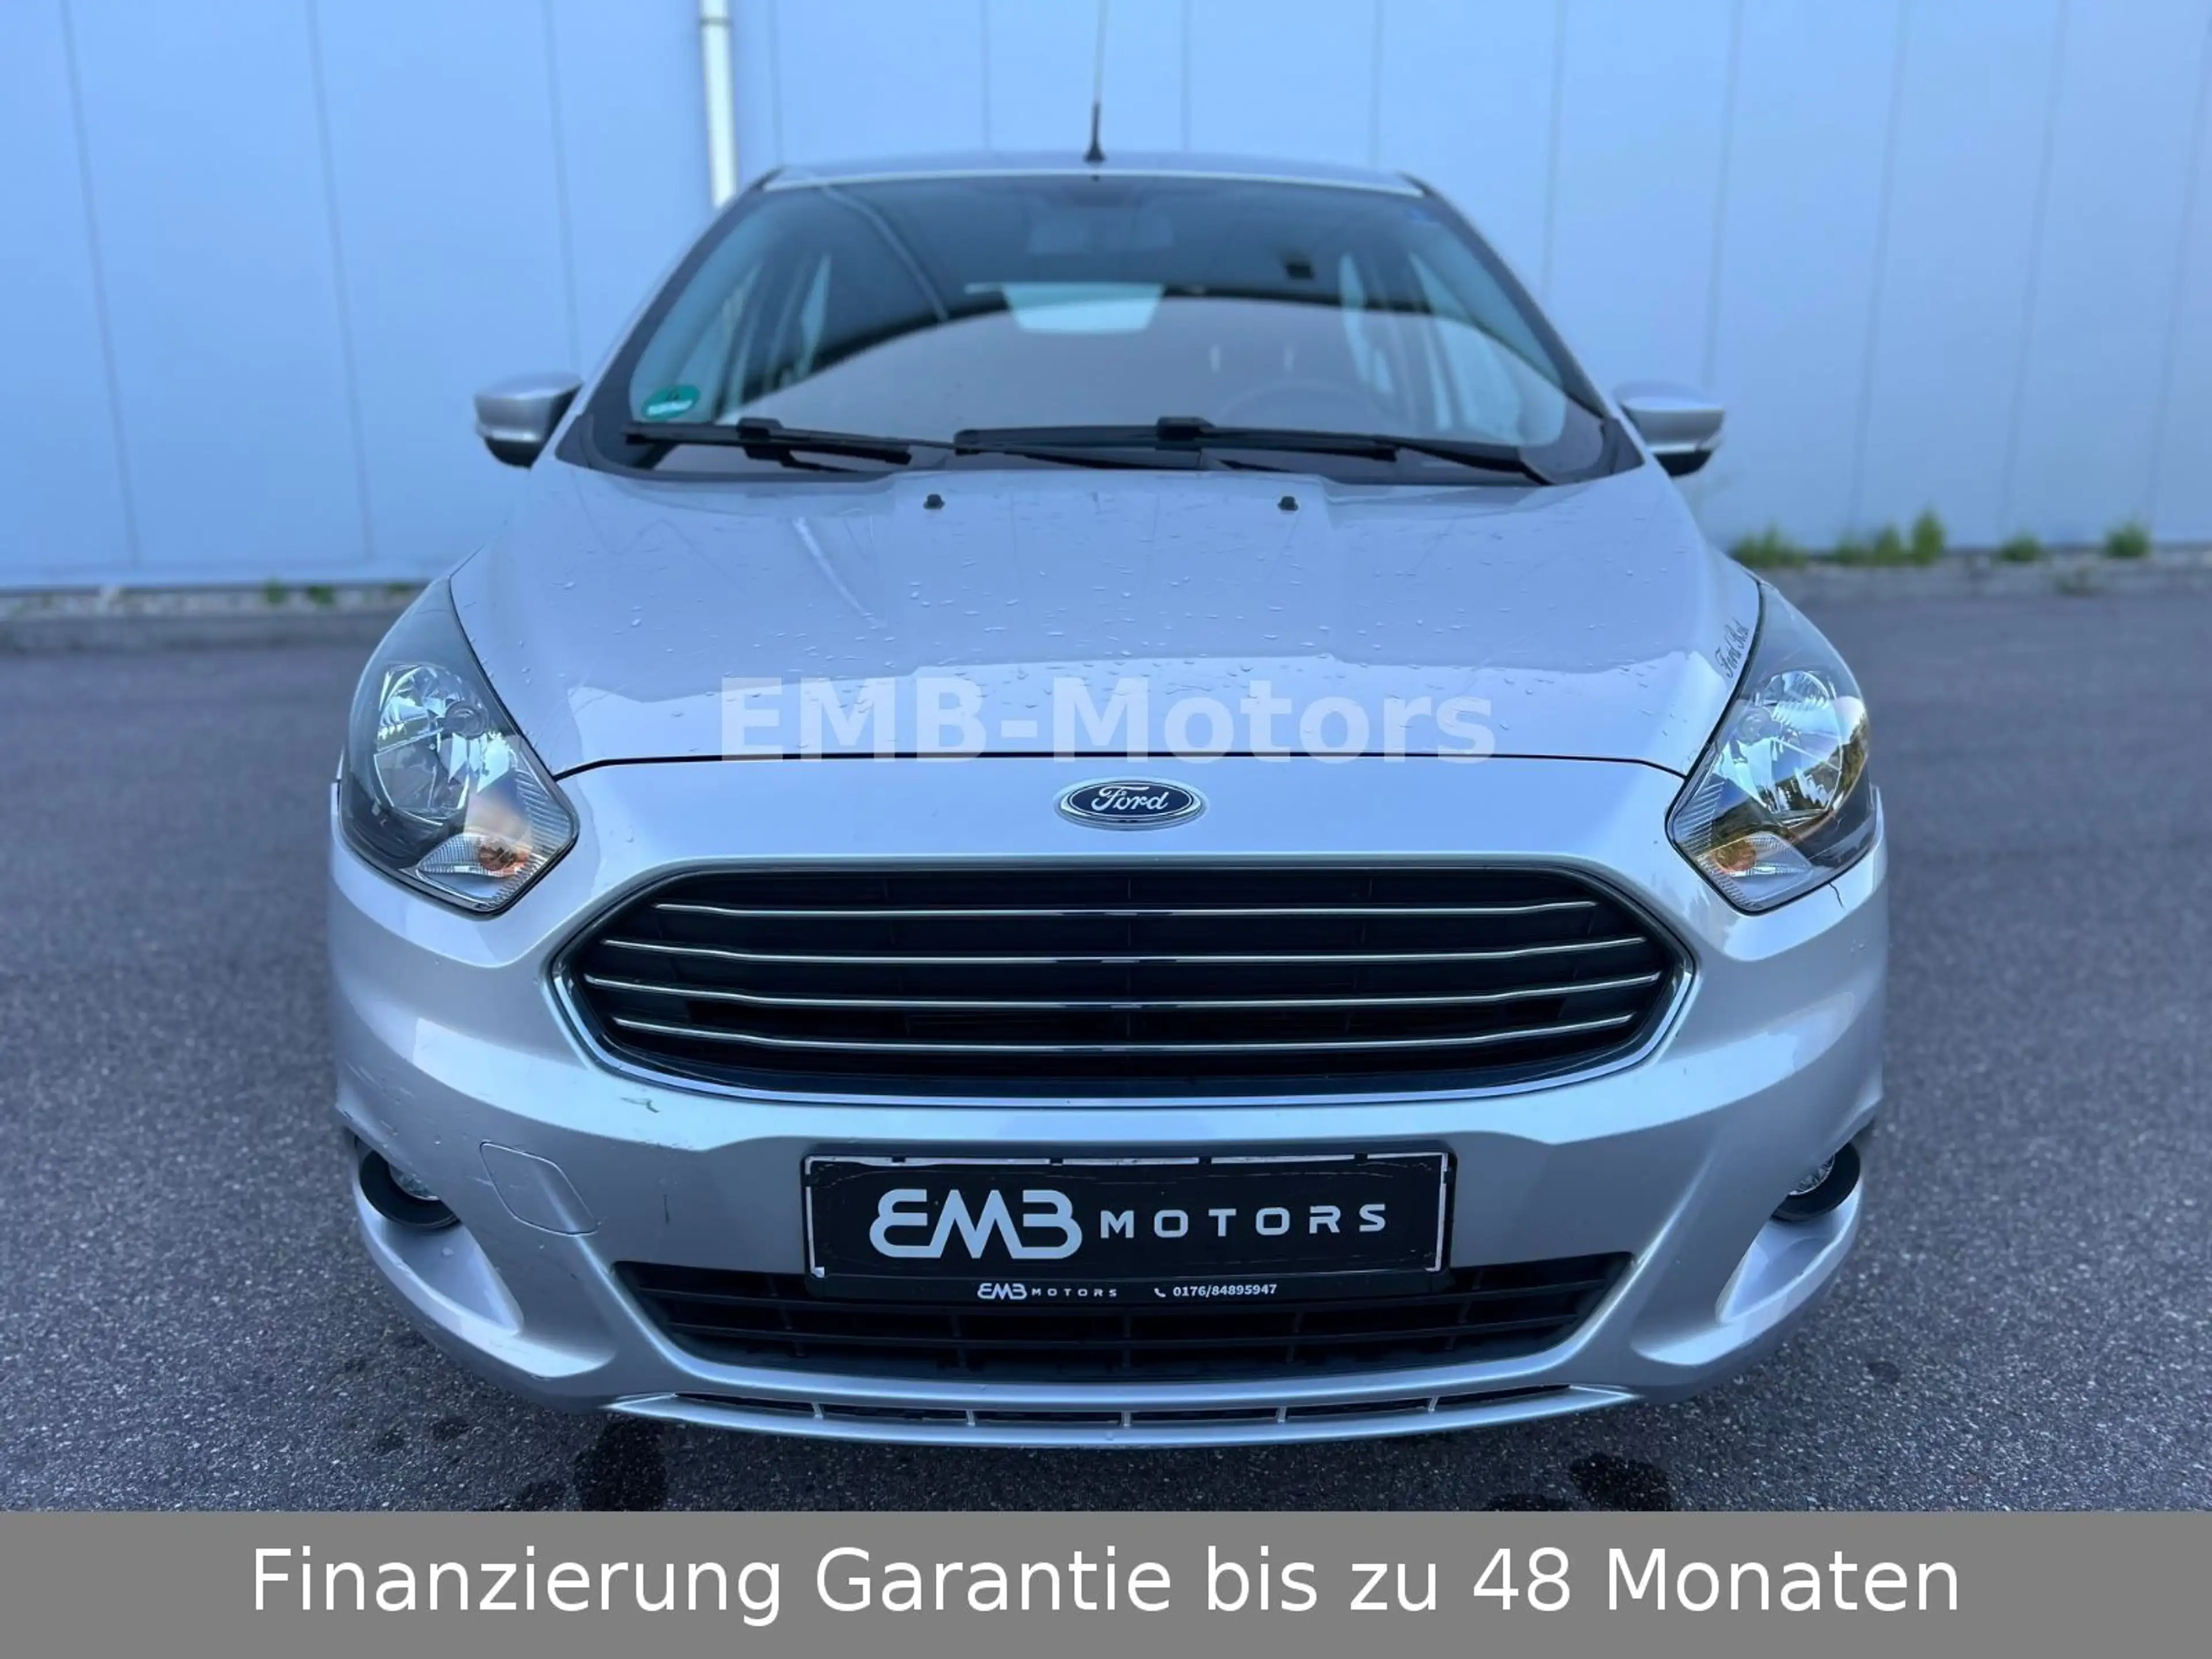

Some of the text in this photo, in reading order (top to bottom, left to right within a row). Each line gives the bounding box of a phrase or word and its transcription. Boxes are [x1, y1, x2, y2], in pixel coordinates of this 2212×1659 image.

[1091, 785, 1169, 812] Ford
[869, 1189, 1386, 1259] EMB MOTORS
[977, 1283, 1277, 1300] EMB MOTORS 0176/84895947
